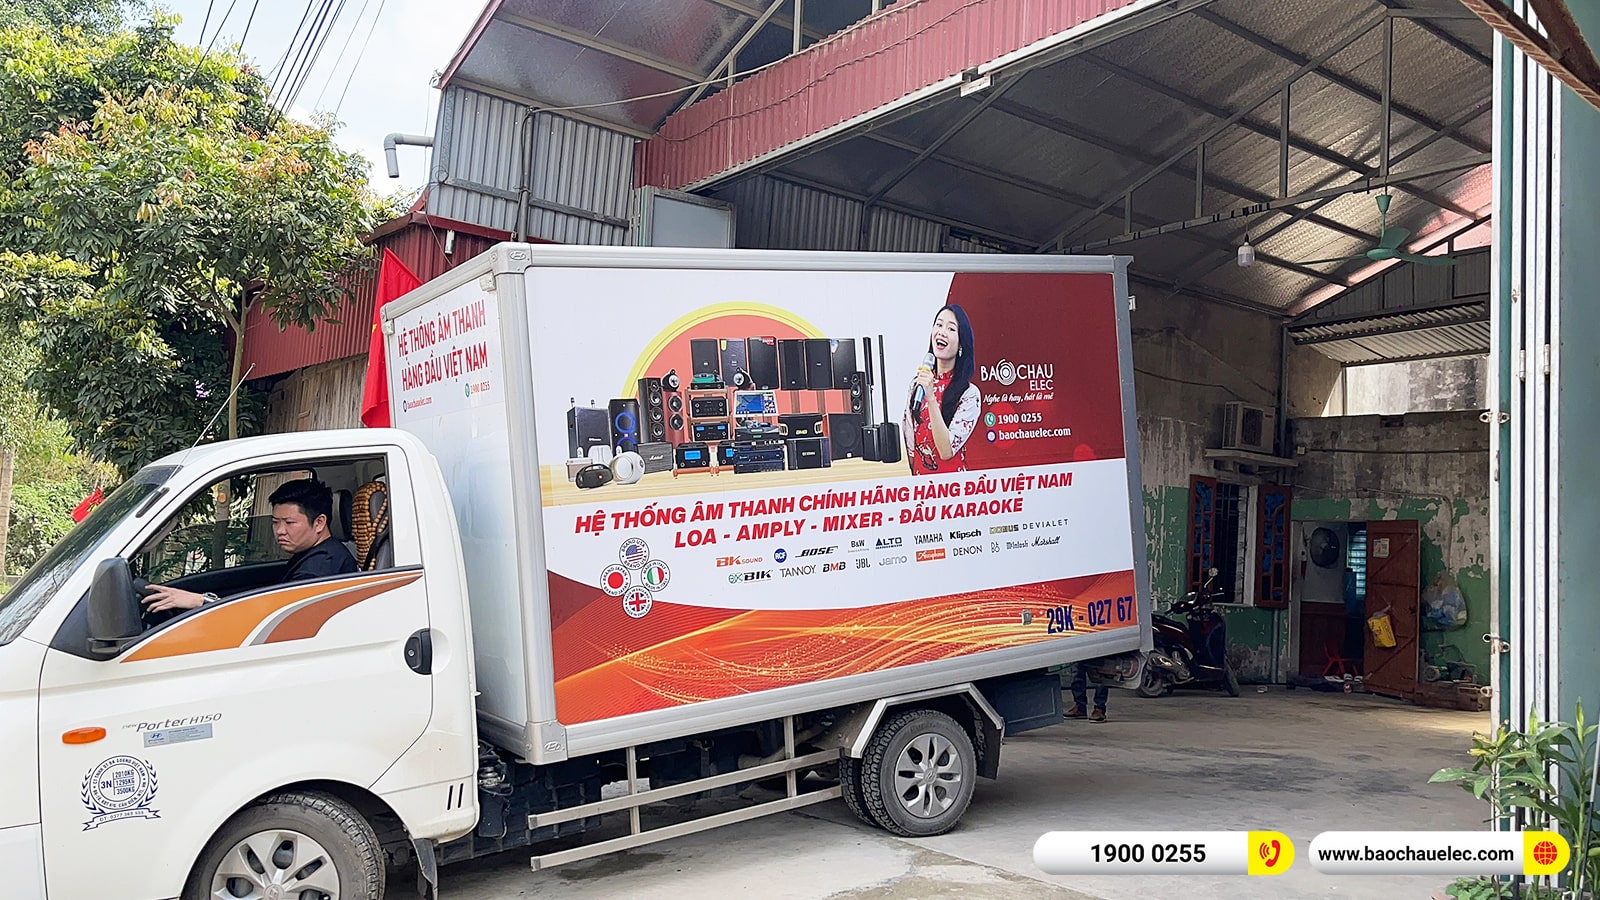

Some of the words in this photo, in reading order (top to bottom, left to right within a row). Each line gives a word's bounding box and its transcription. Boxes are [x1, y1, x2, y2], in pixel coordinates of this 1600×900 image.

[398, 327, 408, 360] HỆ
[409, 316, 436, 353] THỐNG
[438, 312, 452, 342] ÂM
[452, 299, 486, 336] THANH
[402, 361, 423, 392] HÀNG
[425, 350, 442, 385] ĐẦU
[443, 345, 462, 382] VIỆT
[465, 341, 488, 373] NAM
[1030, 380, 1054, 390] ELEC
[983, 394, 1000, 405] Nghe
[998, 414, 1019, 424] 1900
[1021, 412, 1042, 422] 0255
[998, 428, 1072, 440] baochauelec.com
[575, 510, 606, 536] HỆ
[611, 502, 686, 529] THỐNG
[690, 501, 724, 522] ÂM
[728, 497, 795, 518] THANH
[799, 489, 856, 511] CHÍNH
[860, 485, 910, 506] HÃNG
[913, 481, 961, 502] HÀNG
[964, 474, 998, 498] ĐẦU
[1001, 473, 1035, 495] VIỆT
[1037, 472, 1073, 490] NAM
[674, 528, 717, 549] LOA
[736, 519, 806, 542] AMPLY
[822, 511, 883, 532] MIXER
[899, 501, 936, 524] ĐẦU
[940, 498, 1024, 520] KARAOKE
[1022, 519, 1068, 530] DEVIALET
[914, 533, 944, 544] YAMAHA
[949, 528, 982, 541] Klipsch
[622, 540, 636, 552] BRAND
[876, 537, 902, 546] ALTO
[1031, 536, 1060, 547] Marshall
[774, 550, 787, 561] RCF
[795, 546, 838, 558] BOSE
[953, 545, 983, 557] DENON
[822, 562, 846, 572] BMB
[856, 558, 870, 570] JBL
[780, 564, 816, 578] TANNOY
[1046, 605, 1074, 634] 29K
[1088, 599, 1112, 627] 027
[1117, 596, 1132, 622] 67
[136, 717, 188, 732] Porter
[190, 713, 222, 724] H150
[116, 769, 134, 778] 2010KG
[101, 780, 112, 789] 3N
[116, 778, 134, 786] 1295KG
[117, 786, 135, 794] 3500KG
